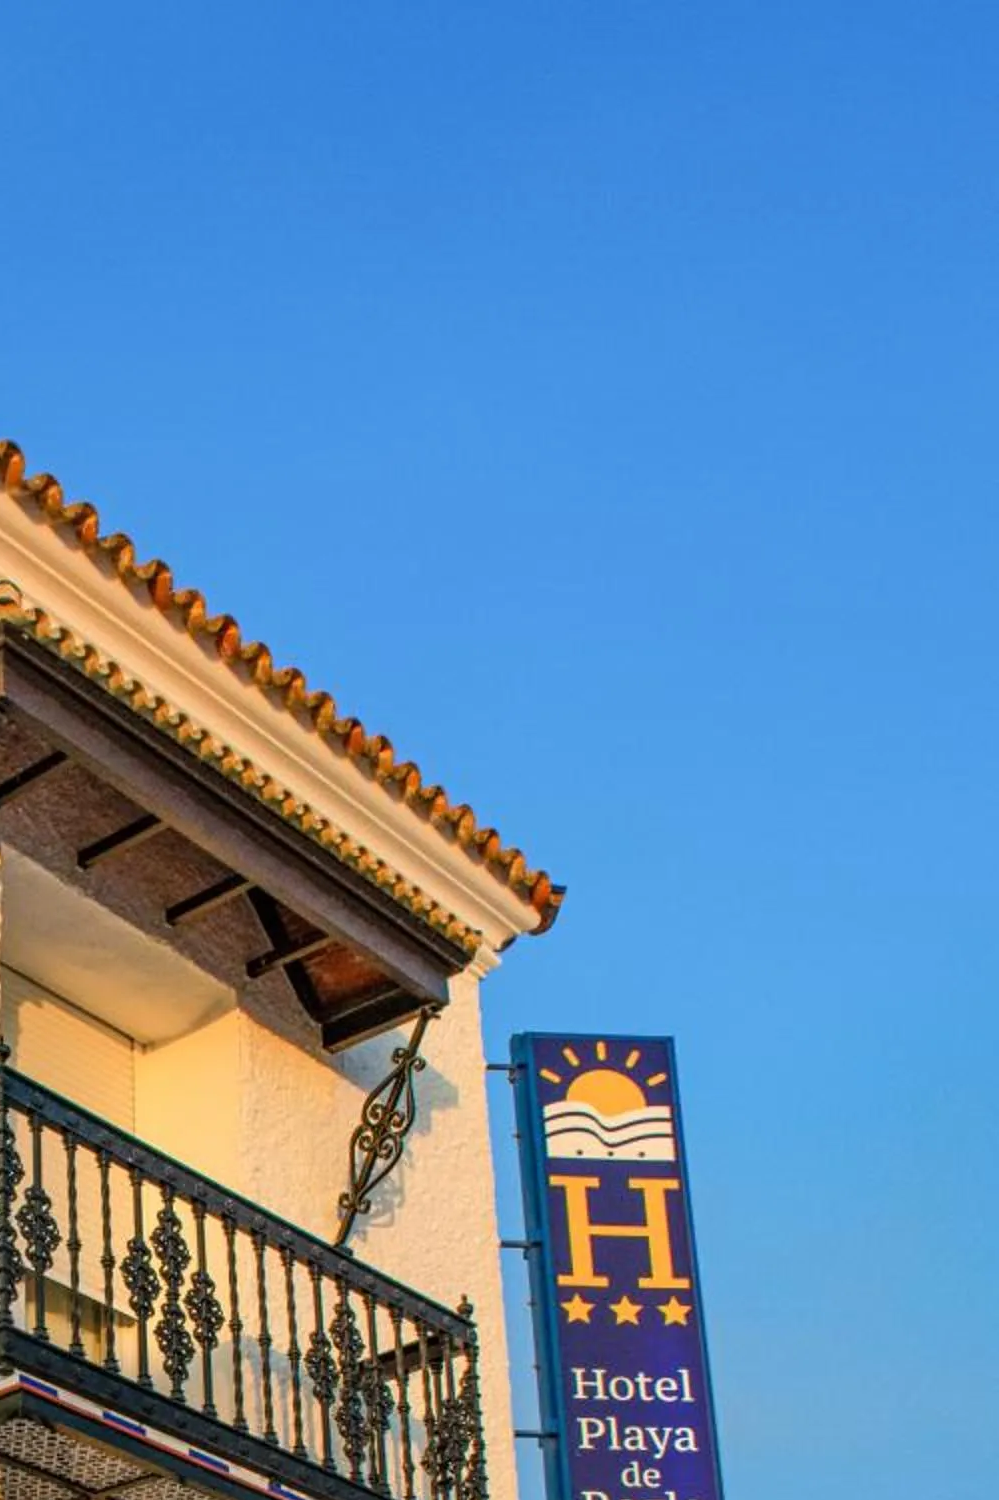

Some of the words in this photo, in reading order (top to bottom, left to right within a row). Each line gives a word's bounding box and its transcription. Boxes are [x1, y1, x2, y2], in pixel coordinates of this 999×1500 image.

[549, 1174, 690, 1289] H
[571, 1367, 695, 1402] Hotel
[576, 1416, 699, 1459] Playa
[621, 1461, 662, 1488] de
